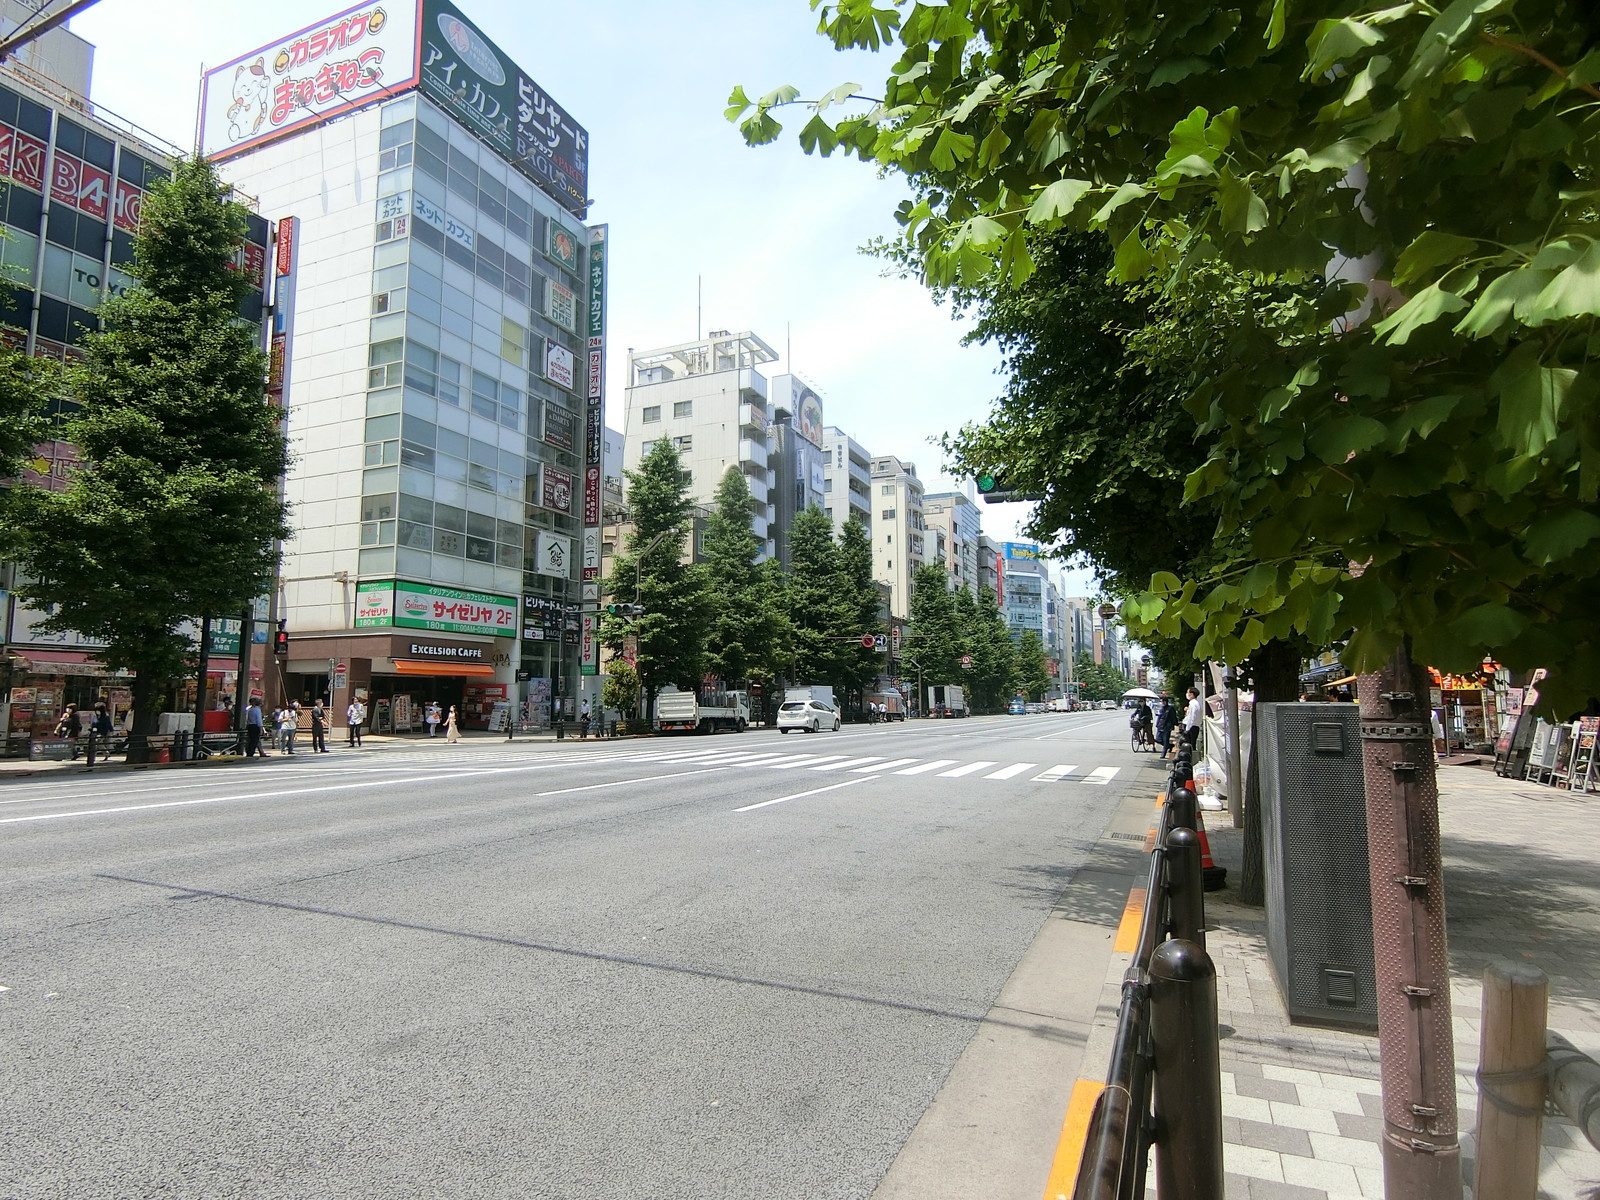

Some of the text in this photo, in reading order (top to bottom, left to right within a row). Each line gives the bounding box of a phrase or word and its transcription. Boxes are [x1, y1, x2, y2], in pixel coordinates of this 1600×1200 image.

[287, 13, 371, 70] カラオケ
[270, 48, 384, 124] まねきねこ
[424, 41, 512, 134] アイ・カフェ
[517, 104, 561, 148] ダーツ
[518, 77, 587, 151] ビリヤード
[517, 123, 554, 158] ダーツショップ
[575, 152, 586, 175] 5F
[382, 207, 403, 219] カフェ
[384, 195, 403, 209] ネット
[397, 219, 406, 229] 24
[416, 199, 472, 246] ネット カフェ
[591, 266, 602, 332] ネットカフェ
[591, 353, 600, 394] カラオケ
[546, 402, 573, 420] BILLIARDS
[553, 413, 570, 427] DARTS
[585, 571, 598, 579] 3F
[360, 608, 389, 617] サイゼリヤ
[433, 600, 513, 625] サイゼリヤ 2F
[525, 596, 580, 611] ビリヤード&ーツ
[411, 644, 483, 658] EXCELSIOR CAFFÉ
